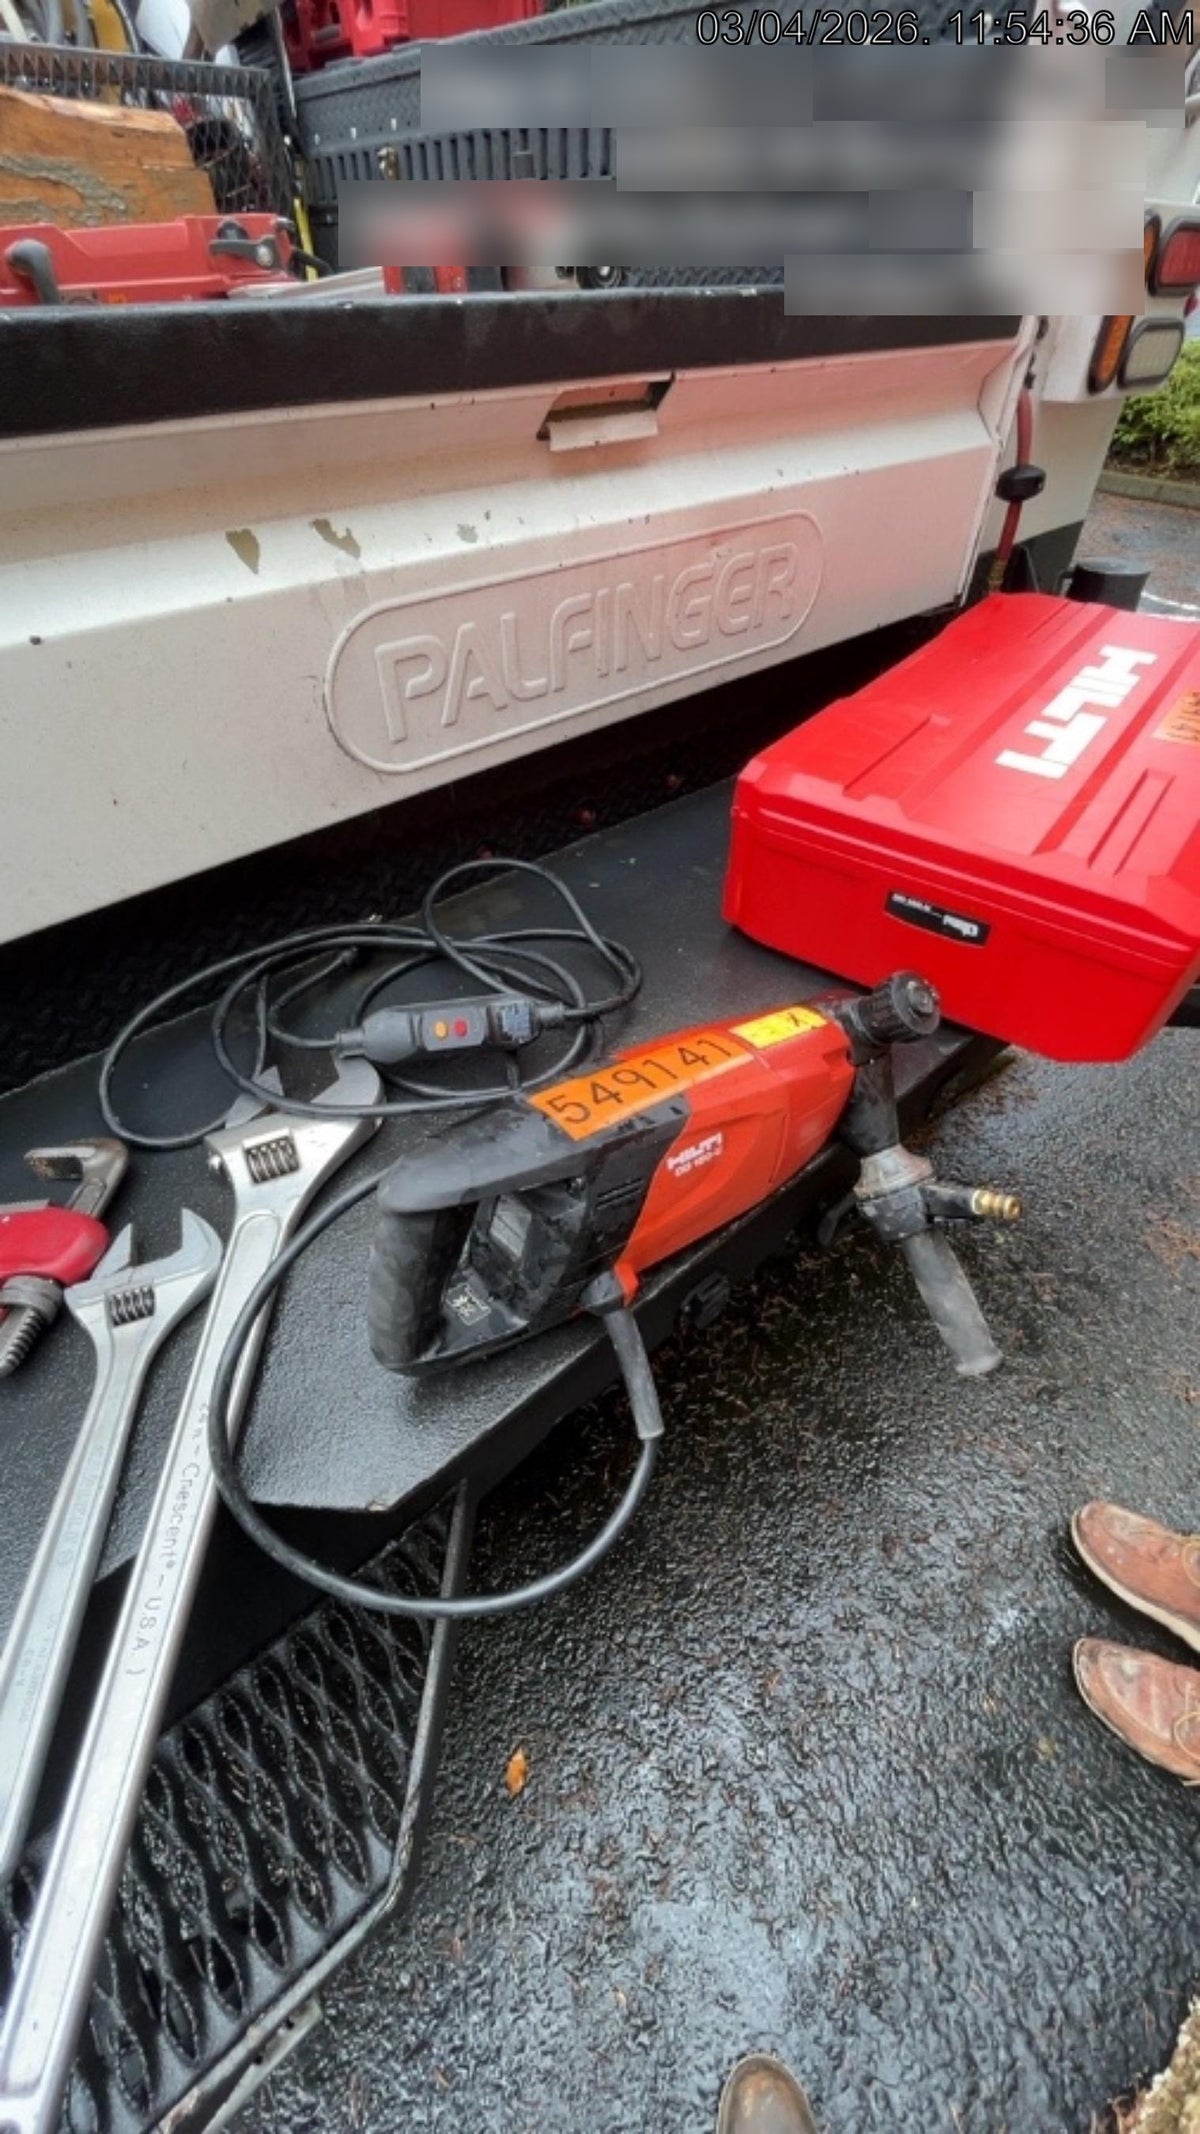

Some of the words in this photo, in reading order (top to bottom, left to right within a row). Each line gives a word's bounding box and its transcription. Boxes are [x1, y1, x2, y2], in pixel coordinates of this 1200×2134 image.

[373, 541, 799, 744] PALFINGER
[994, 644, 1158, 779] HILTI
[545, 1038, 732, 1125] 549141
[667, 1131, 723, 1170] HILTI
